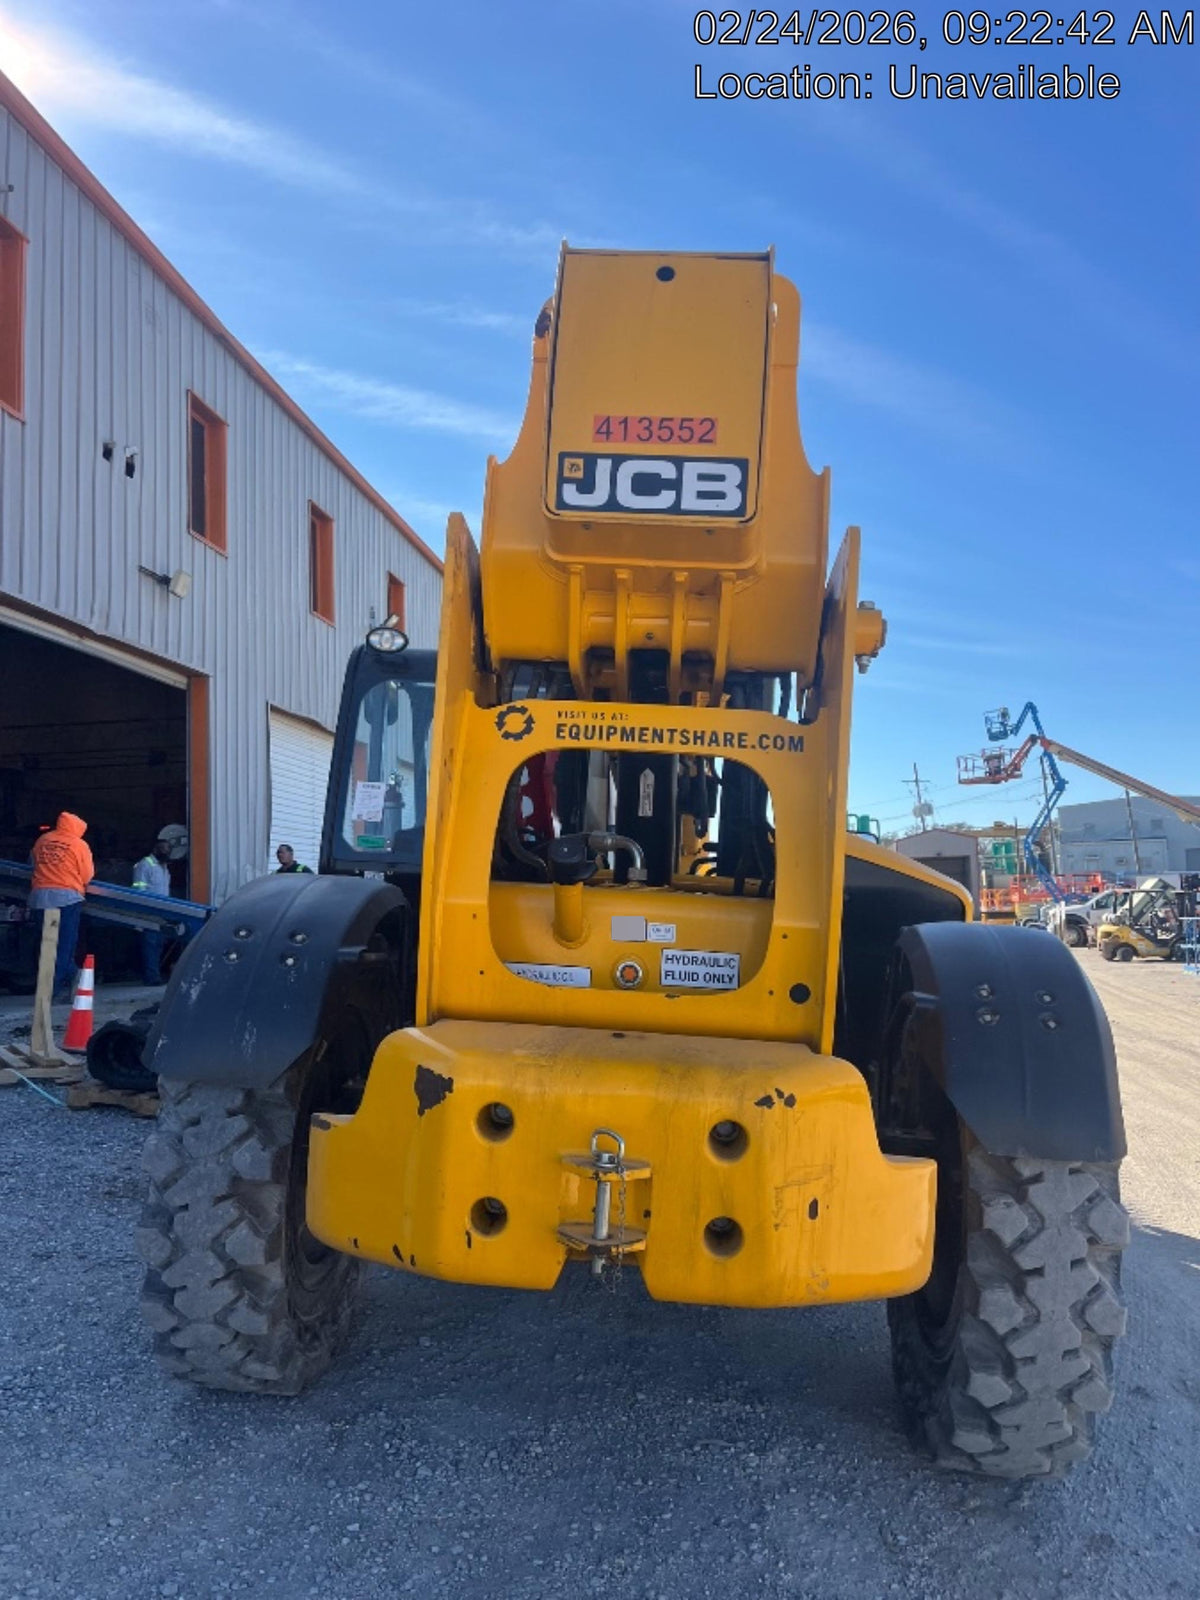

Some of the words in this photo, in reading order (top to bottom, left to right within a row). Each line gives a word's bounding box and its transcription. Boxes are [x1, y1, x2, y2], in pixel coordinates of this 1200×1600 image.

[595, 415, 716, 443] 413552
[561, 458, 743, 512] JCB
[557, 710, 587, 719] VISIT
[592, 711, 606, 720] US
[611, 712, 629, 721] AT:
[555, 722, 805, 753] EQUIPMENTSHARE.COM
[664, 954, 737, 970] HYDRAULIC
[664, 970, 700, 983] FLUID
[703, 972, 736, 985] ONLY
